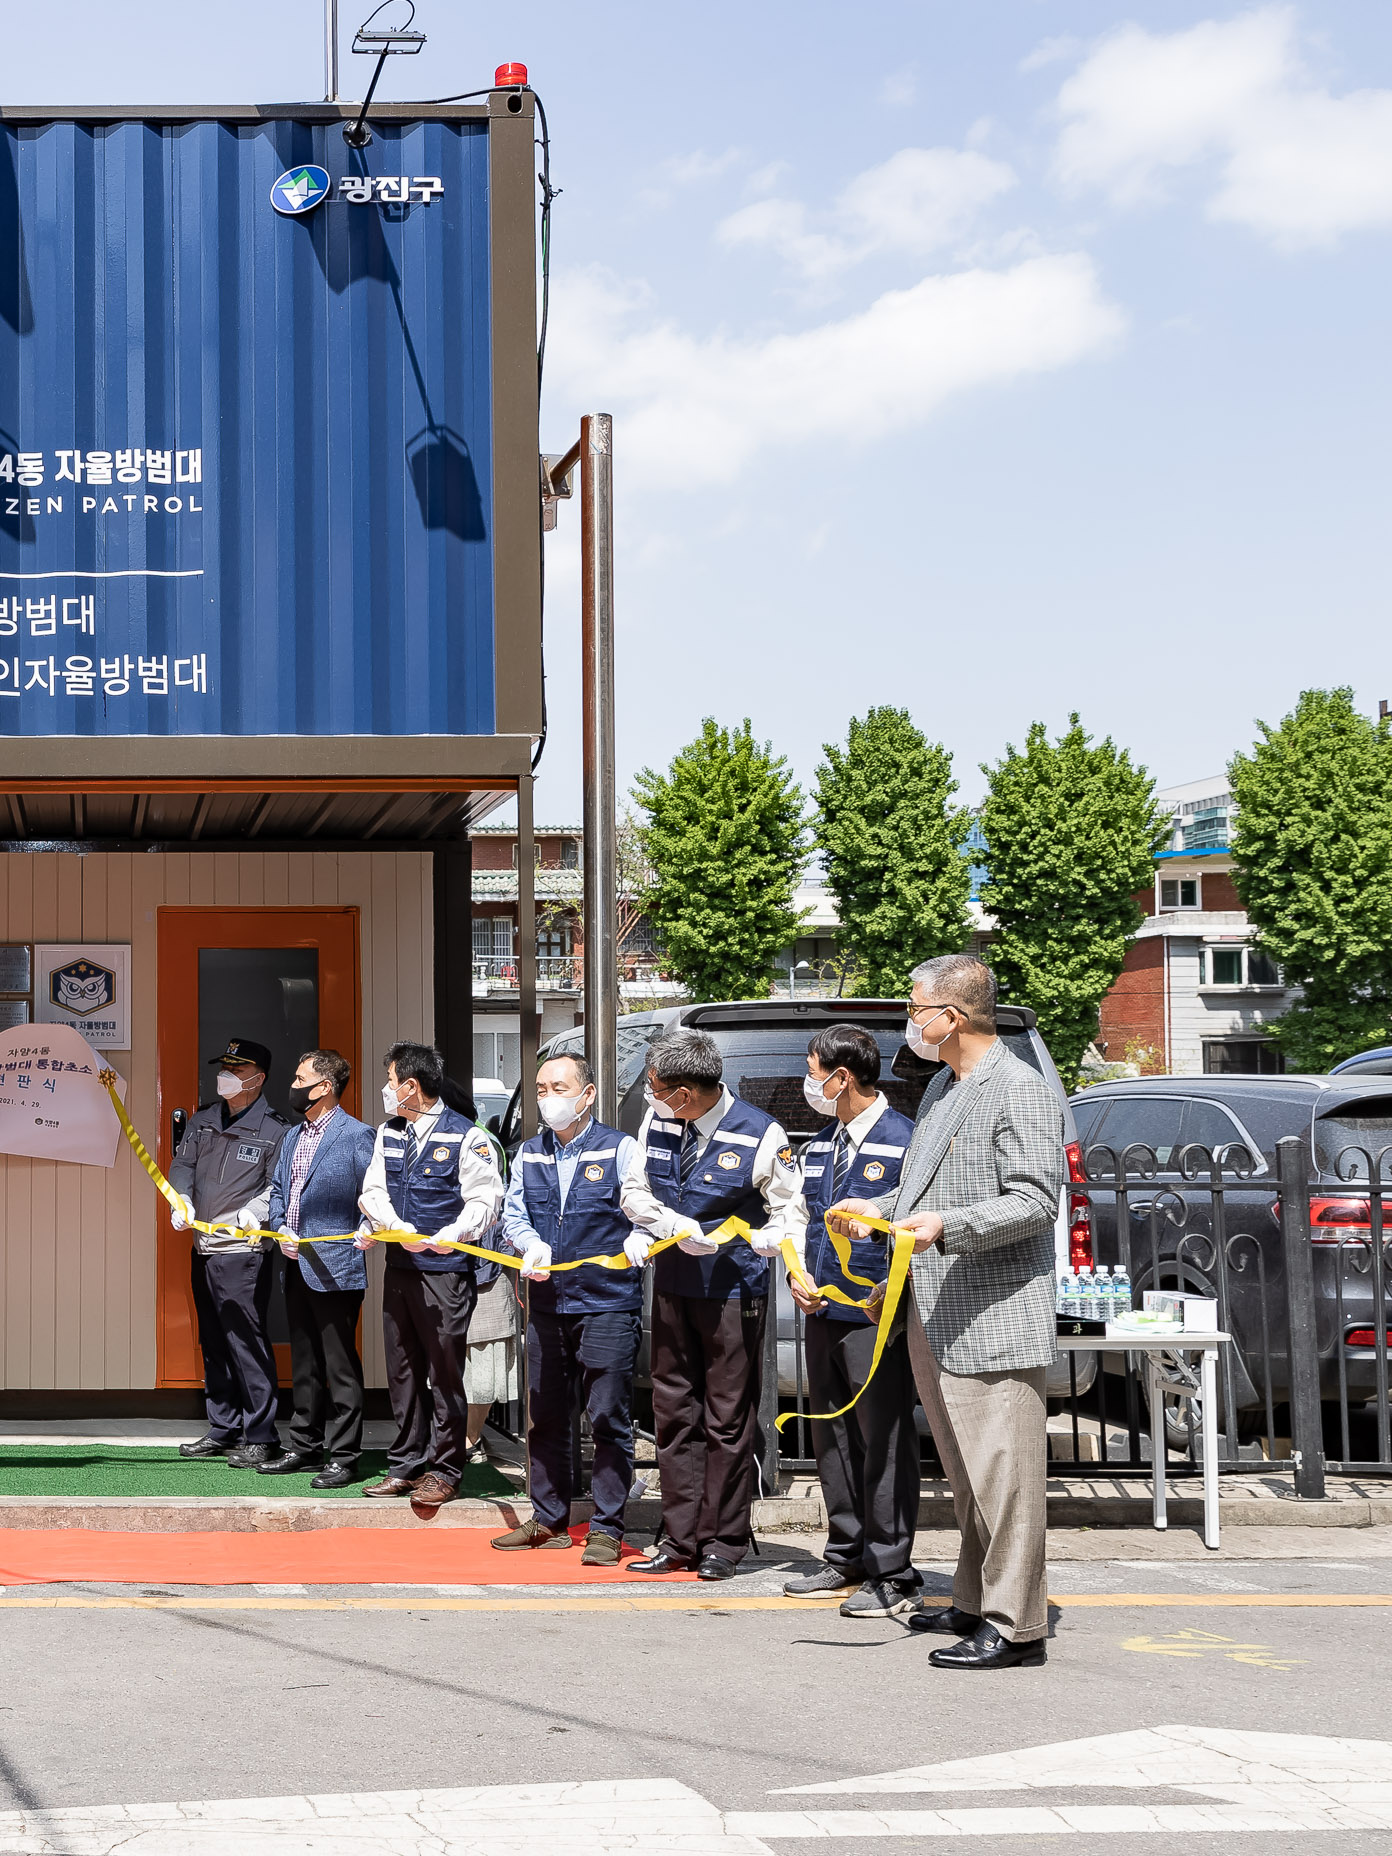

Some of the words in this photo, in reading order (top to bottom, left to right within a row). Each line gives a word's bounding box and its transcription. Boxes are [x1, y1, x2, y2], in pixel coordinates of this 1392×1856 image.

[338, 176, 445, 203] 광진구
[54, 448, 203, 485] 자율방범대
[82, 494, 203, 515] PATROL
[78, 1021, 117, 1030] 자율방범대
[7, 1046, 51, 1058] 자양4동
[36, 1058, 93, 1075] 통합초소
[31, 1101, 42, 1109] 29.
[238, 1154, 258, 1162] POLICE
